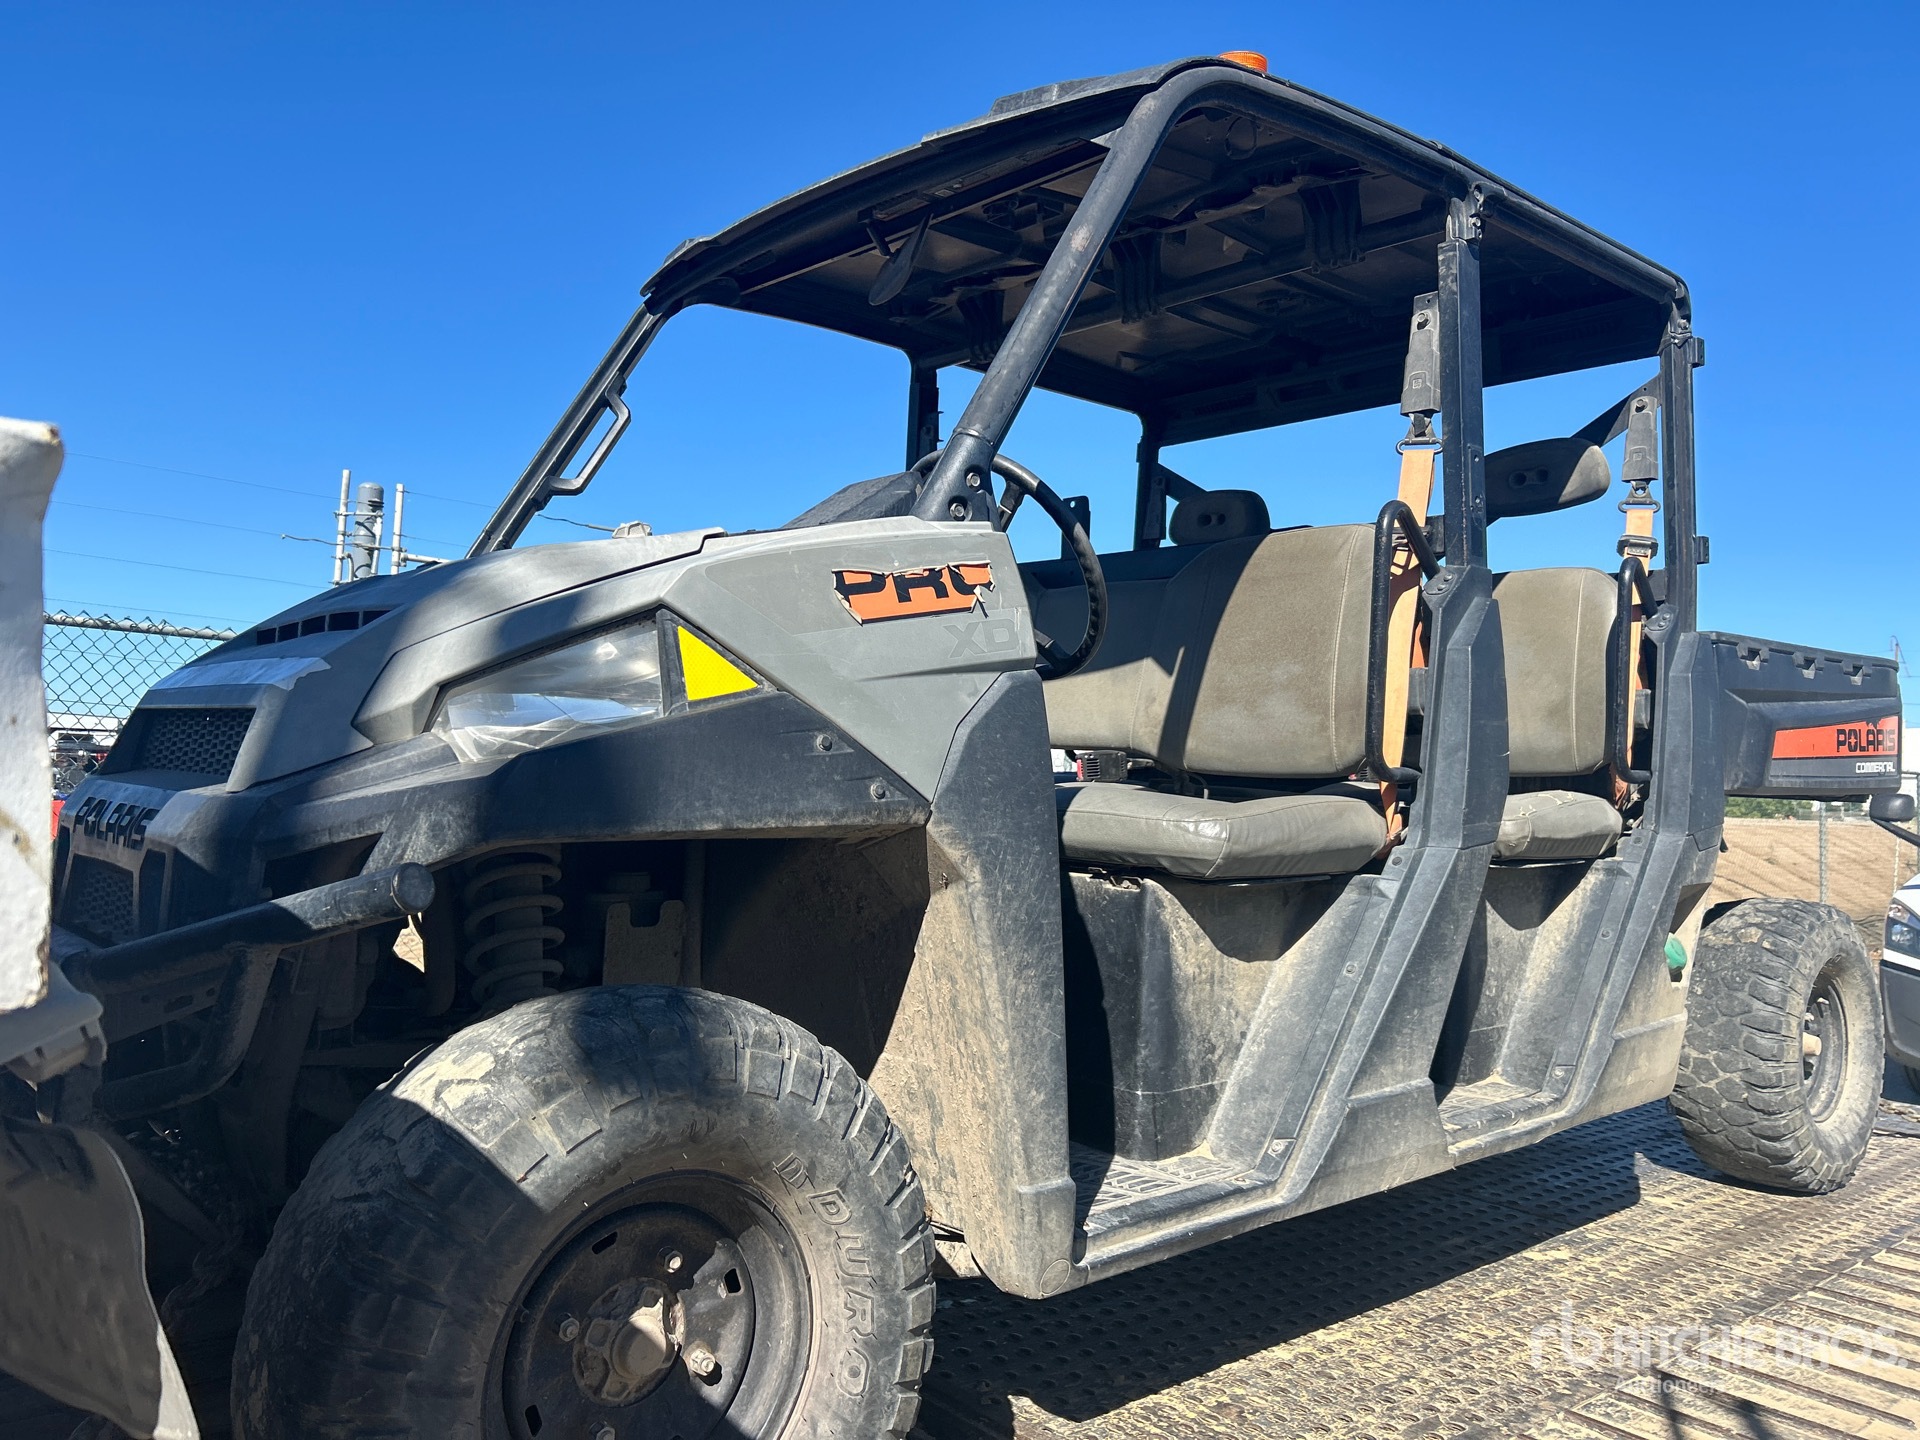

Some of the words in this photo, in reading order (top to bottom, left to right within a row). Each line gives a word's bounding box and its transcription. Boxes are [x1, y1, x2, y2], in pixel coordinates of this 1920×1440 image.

[943, 618, 1019, 659] XD
[1837, 728, 1896, 752] POLARIS
[72, 796, 160, 850] POLARIS
[806, 1188, 875, 1398] DURO
